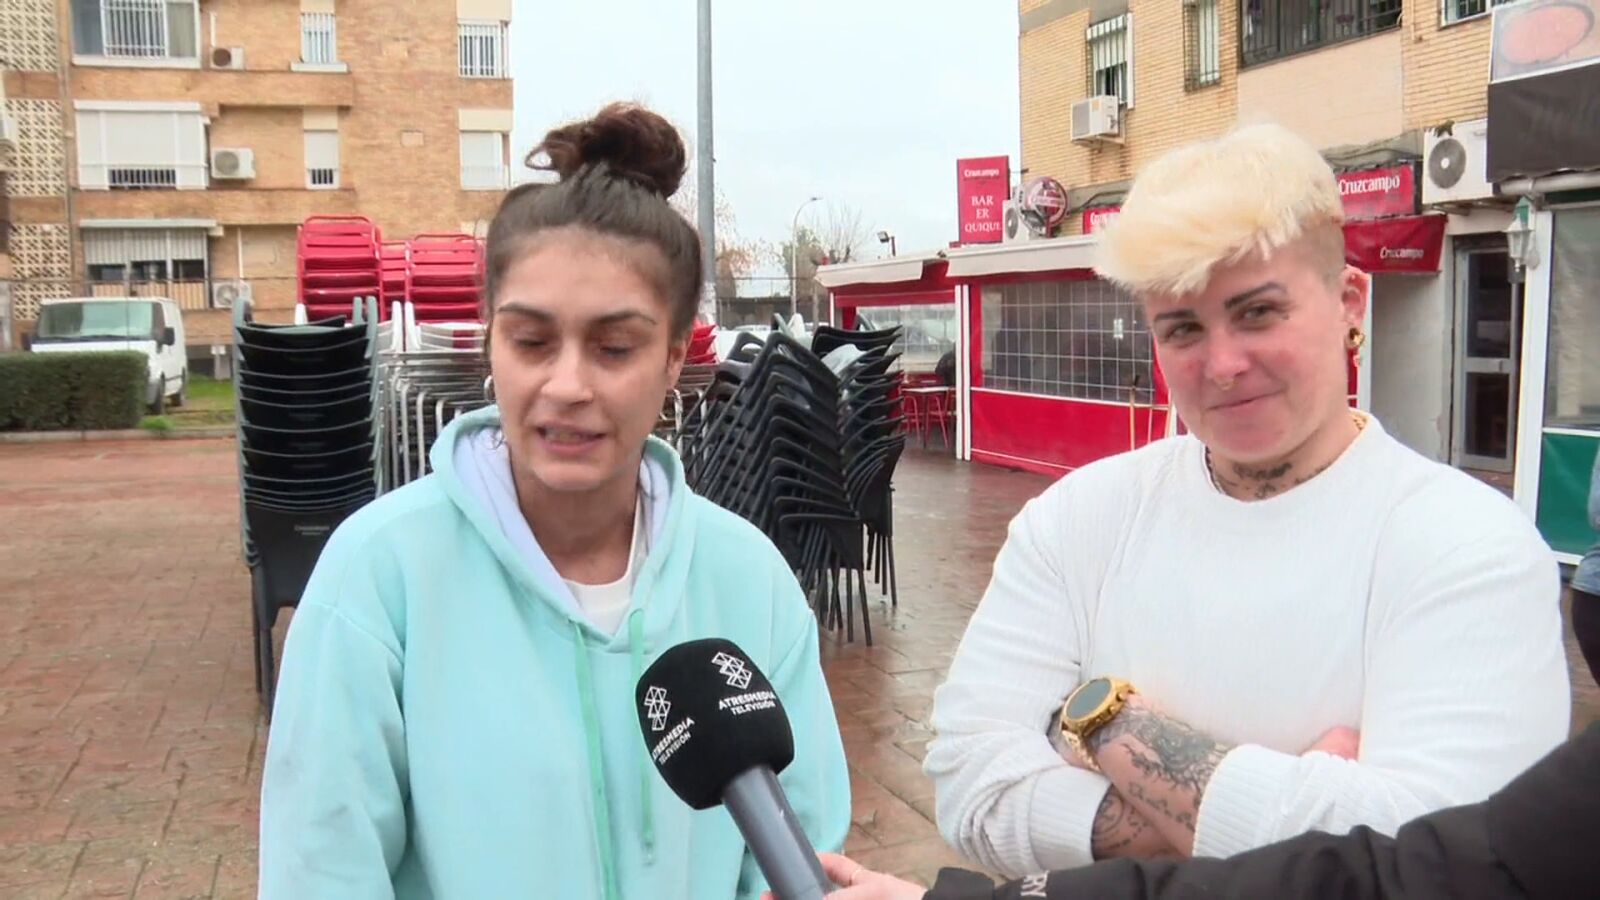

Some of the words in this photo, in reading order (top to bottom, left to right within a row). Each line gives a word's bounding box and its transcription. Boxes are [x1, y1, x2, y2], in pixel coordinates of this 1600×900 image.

[963, 168, 1000, 178] Cruzcampo
[1338, 175, 1400, 195] Cruzcampo
[971, 195, 994, 206] BAR
[976, 208, 990, 219] ER
[1380, 247, 1424, 259] Cruzcampo
[719, 692, 776, 710] ATRESMEDIA
[652, 717, 695, 761] ATRESMEDIA
